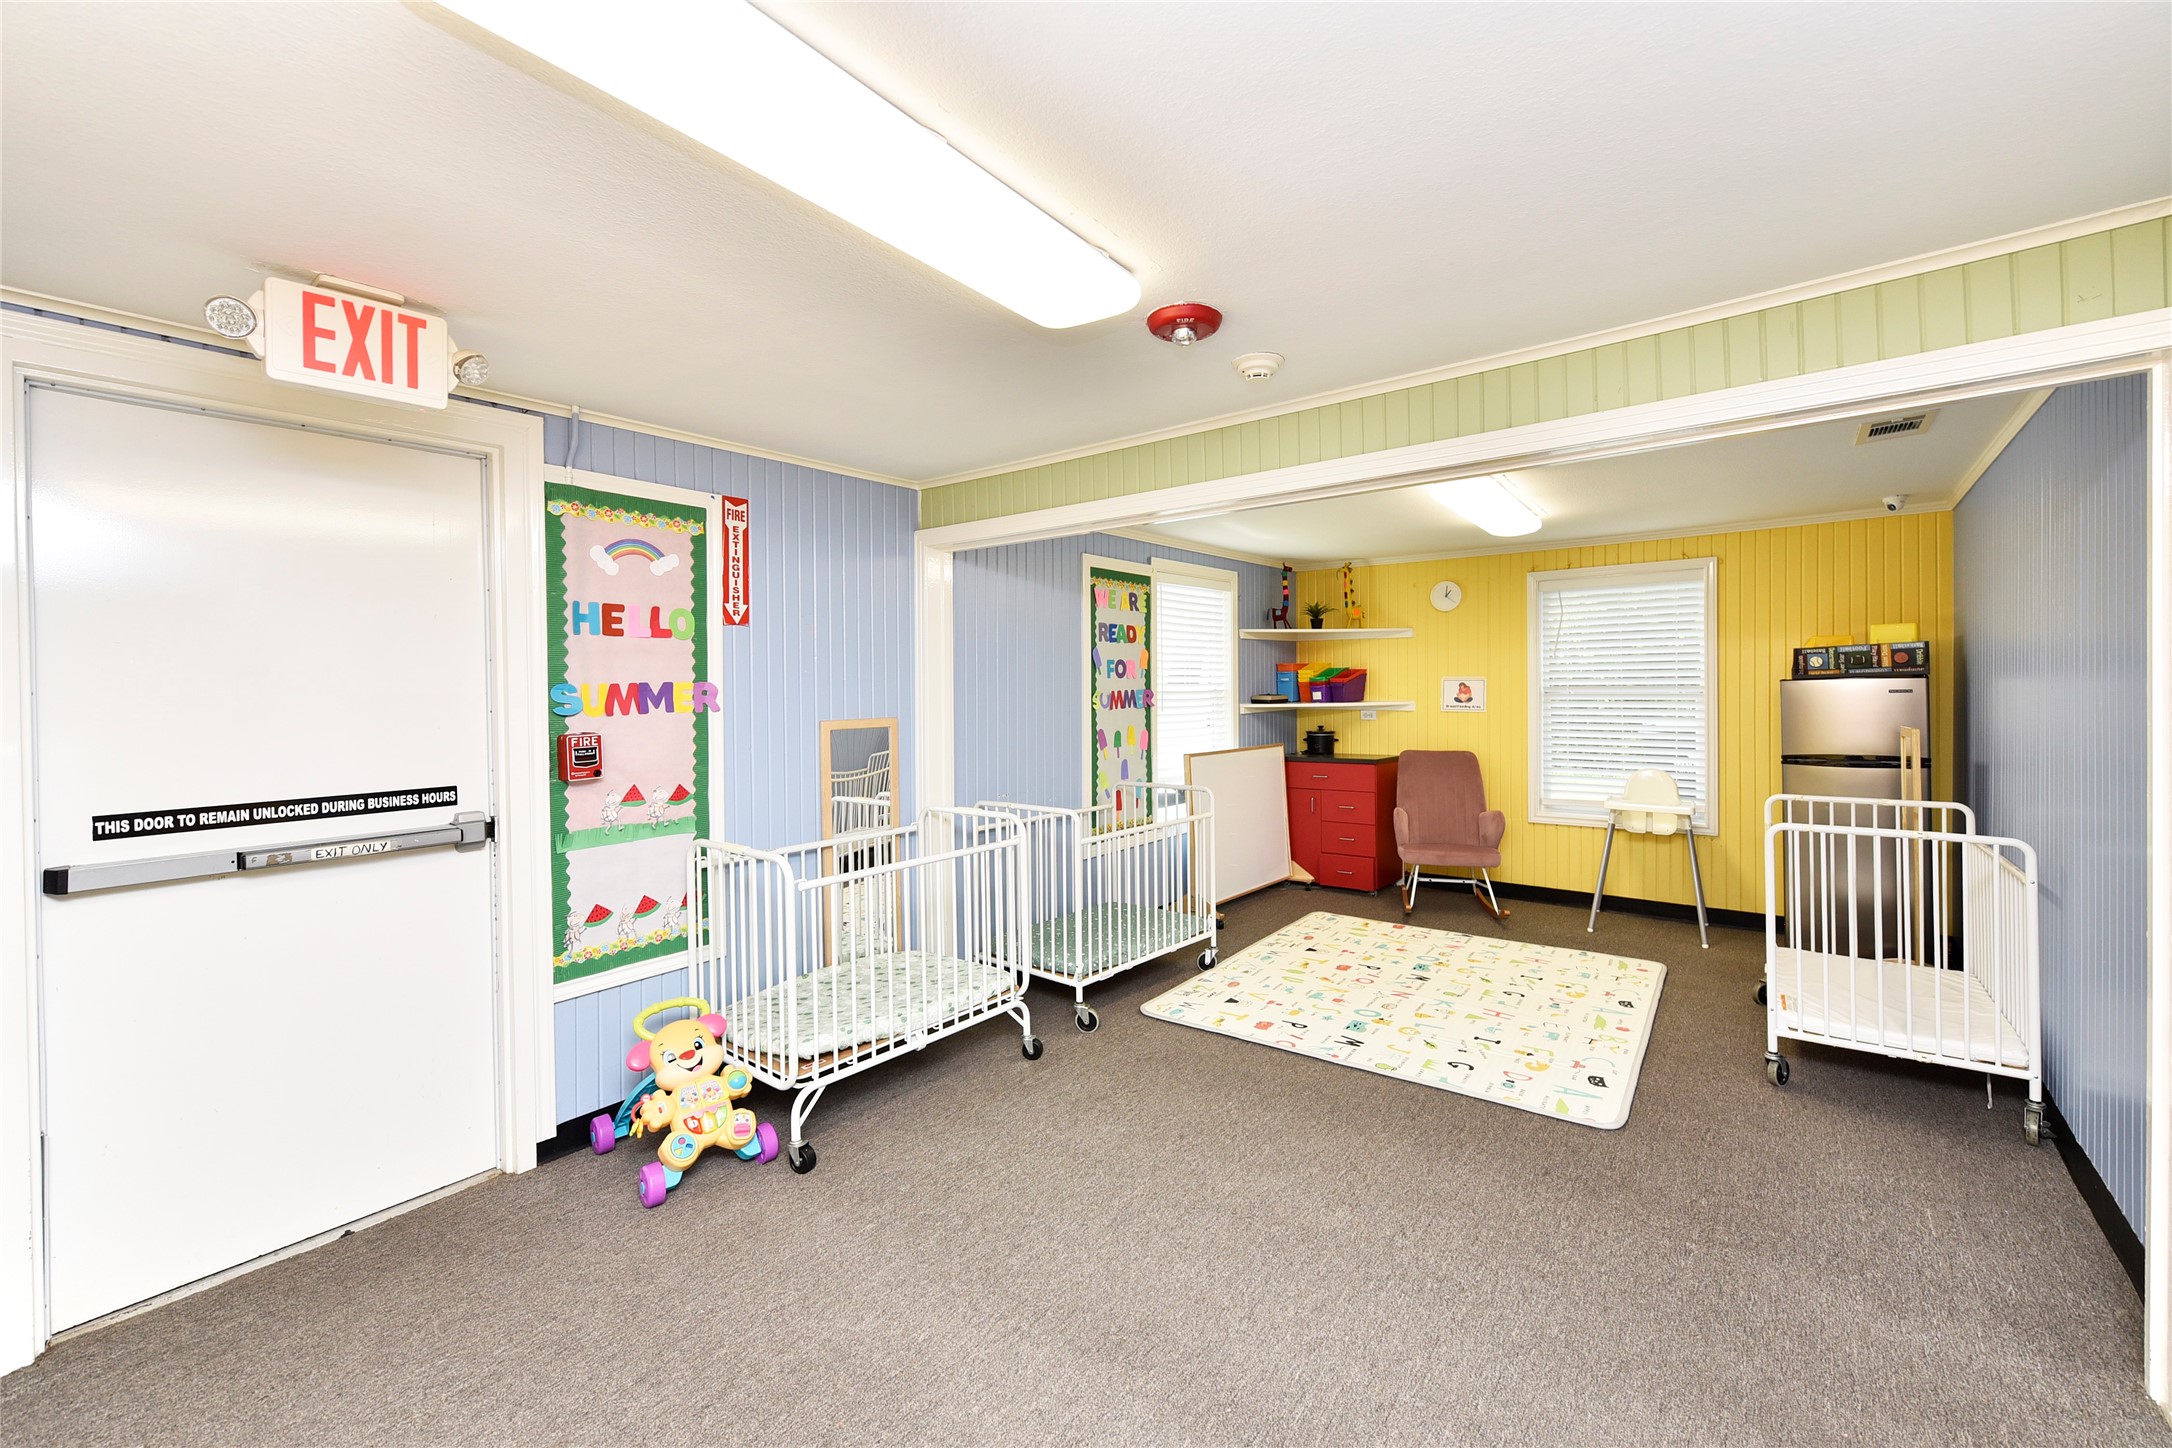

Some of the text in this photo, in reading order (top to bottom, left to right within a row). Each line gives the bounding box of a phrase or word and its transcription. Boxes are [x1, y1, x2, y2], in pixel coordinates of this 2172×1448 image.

[302, 290, 427, 390] EXIT
[726, 508, 746, 522] FIRE
[732, 526, 740, 616] EXTINGUISHER
[1094, 587, 1148, 614] WE ARE
[572, 600, 696, 640] HELLO
[1098, 622, 1146, 644] READY
[1106, 658, 1136, 680] FOR
[550, 682, 720, 717] SUMMER
[1092, 688, 1154, 710] SUMMER
[571, 736, 598, 748] FIRE
[95, 790, 456, 835] THIS DOOR TO REMAIN UNLOCKED DURING BUSINESS HOURS
[316, 842, 388, 858] EXIT ONLY
